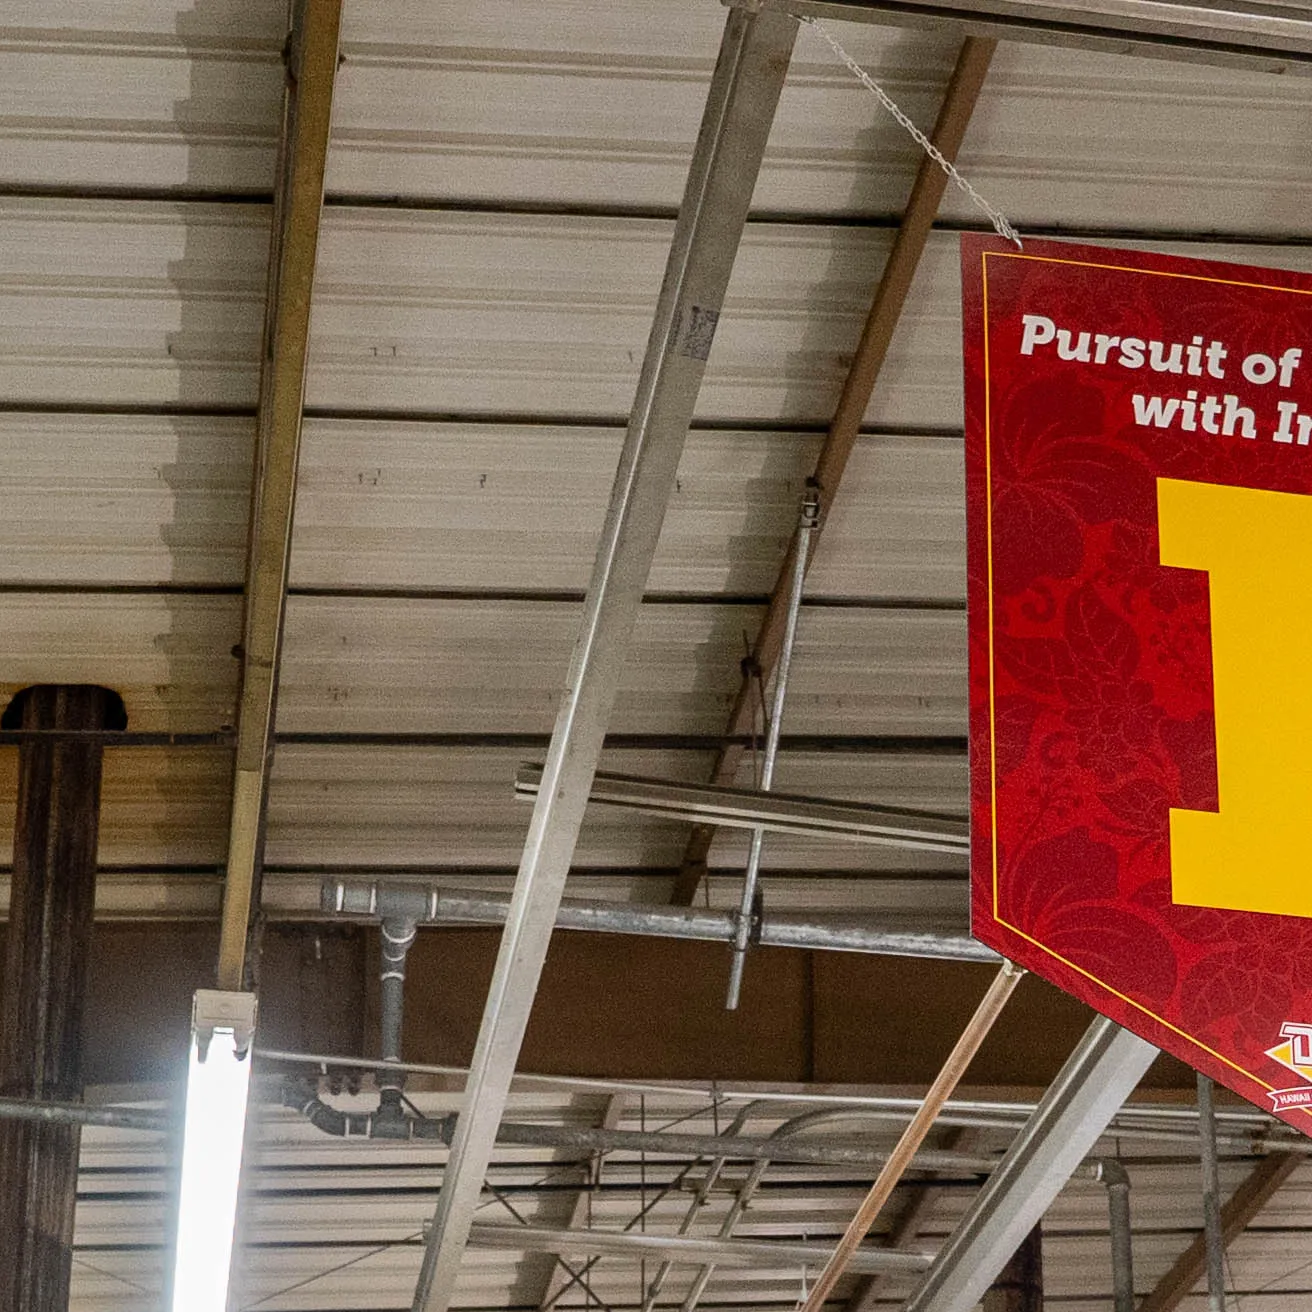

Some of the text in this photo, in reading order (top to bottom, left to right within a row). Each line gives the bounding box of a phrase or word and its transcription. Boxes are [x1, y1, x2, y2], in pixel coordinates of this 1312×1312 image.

[1019, 314, 1228, 380] Pursuit
[1241, 348, 1303, 388] of
[1131, 390, 1257, 439] with
